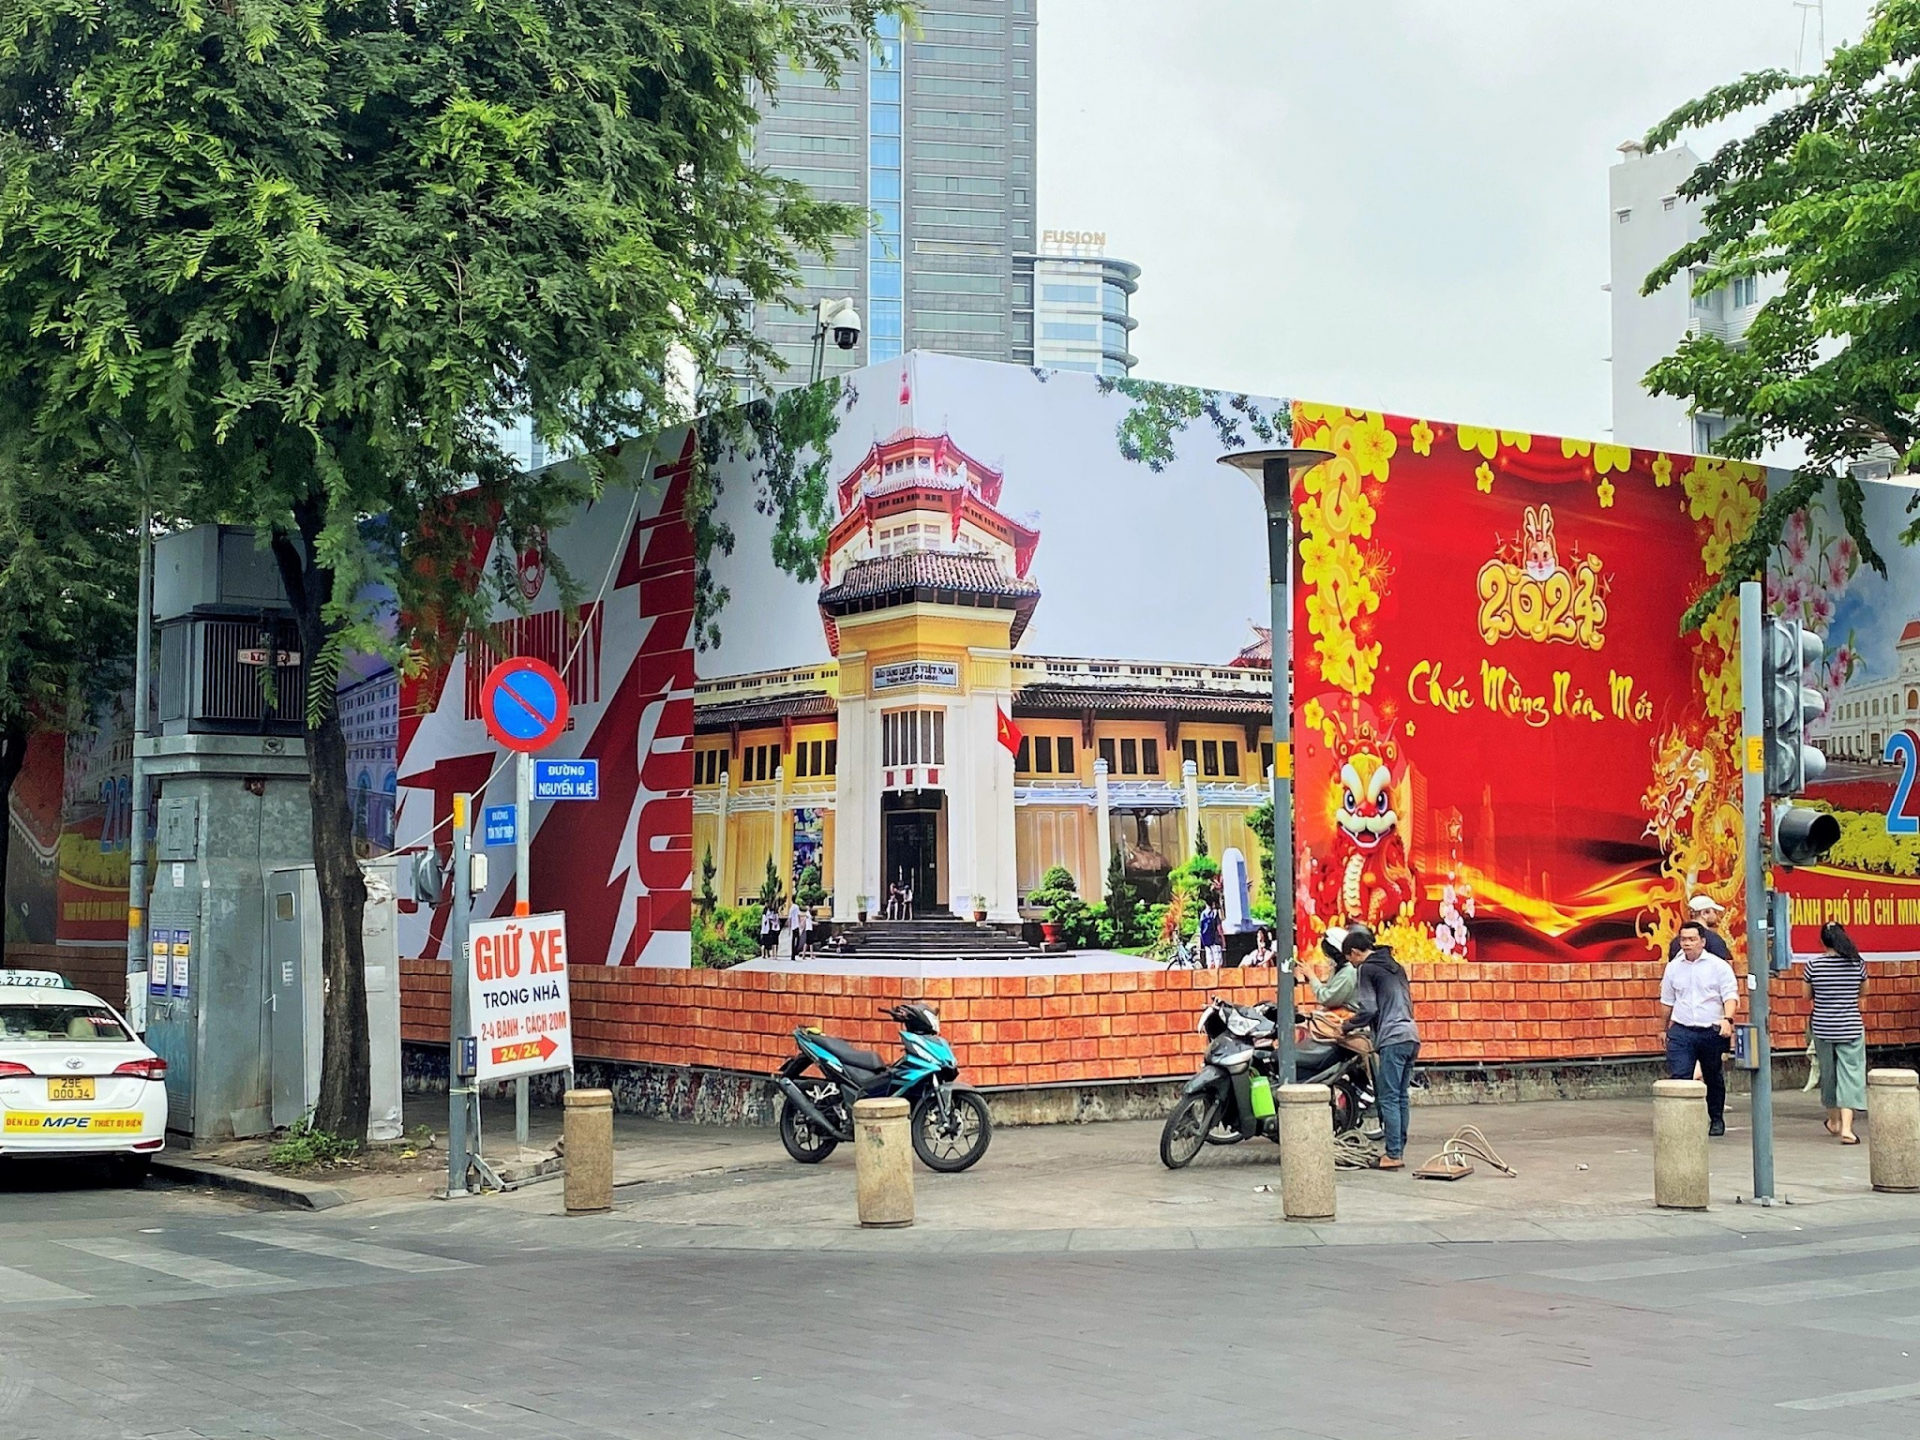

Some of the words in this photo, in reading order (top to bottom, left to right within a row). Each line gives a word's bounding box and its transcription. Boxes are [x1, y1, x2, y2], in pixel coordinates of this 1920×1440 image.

[1043, 230, 1106, 245] FUSION
[1476, 559, 1608, 650] 2024
[1408, 660, 1475, 713] Chúc
[1480, 658, 1549, 727] Mừng
[1608, 669, 1653, 727] Mới
[548, 765, 585, 776] ĐƯỜNG
[538, 778, 573, 795] NGUYỄN
[576, 780, 594, 798] HUỆ
[1789, 892, 1821, 926] HÀNH
[1825, 889, 1850, 926] PHỐ
[1853, 889, 1870, 926] HỒ
[1874, 893, 1894, 926] CHÍ
[475, 924, 522, 981] GIỮ
[529, 929, 565, 975] XE
[26, 976, 40, 986] 27
[44, 977, 59, 987] 27
[483, 988, 529, 1009] TRONG
[533, 980, 560, 1002] NHÀ
[481, 1021, 495, 1041] 2-4
[496, 1016, 519, 1039] BÁNH
[525, 1011, 548, 1034] CÁCH
[548, 1010, 567, 1031] 20M
[500, 1043, 540, 1061] 24/24
[53, 1089, 90, 1098] 000.34
[24, 1118, 40, 1126] LED
[42, 1117, 91, 1128] MPE
